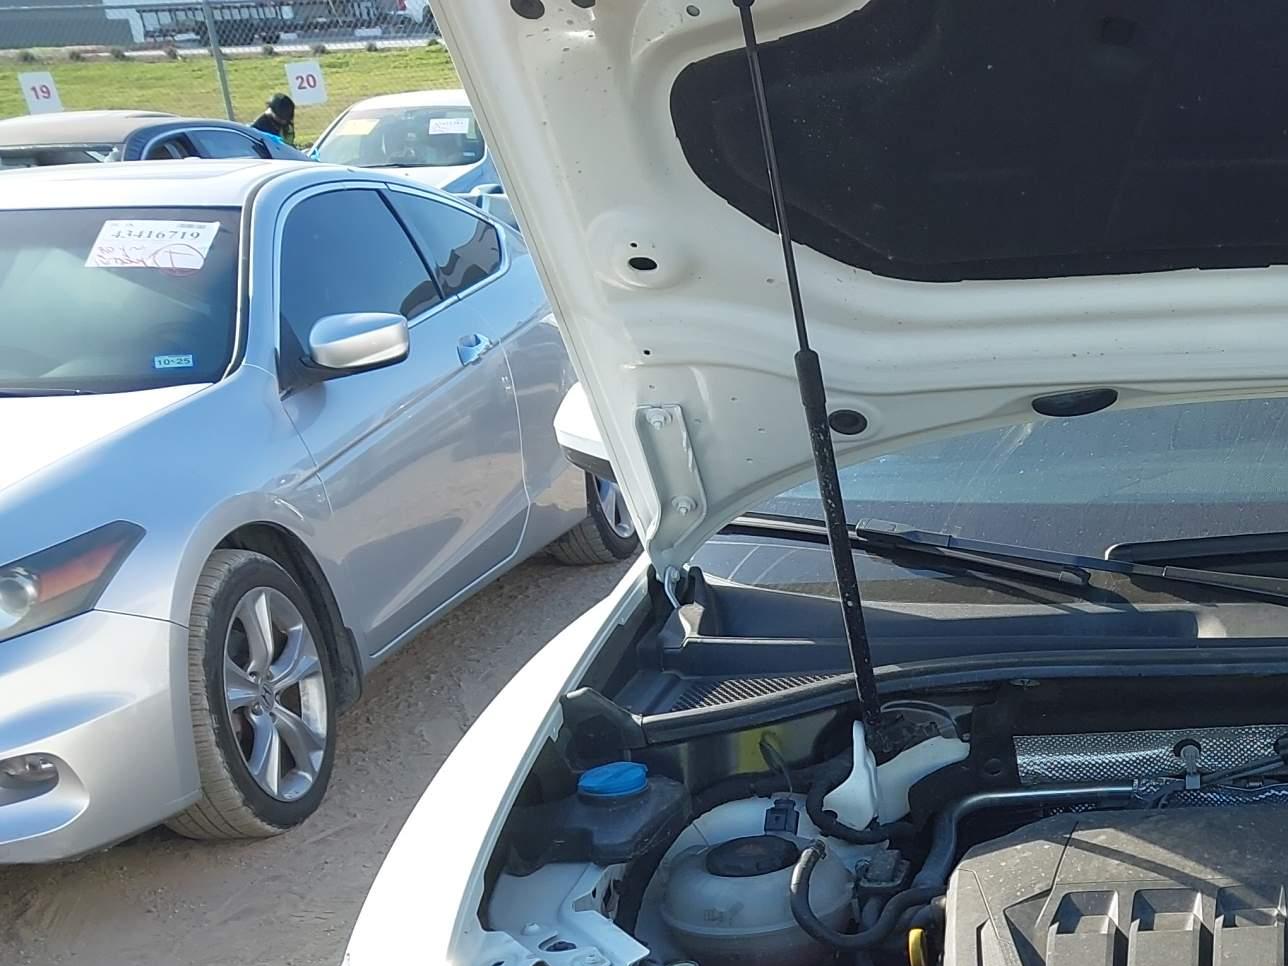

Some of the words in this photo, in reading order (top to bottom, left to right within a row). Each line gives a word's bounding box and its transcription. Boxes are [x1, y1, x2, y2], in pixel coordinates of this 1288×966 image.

[295, 73, 317, 91] 20
[31, 84, 51, 100] 19
[111, 230, 201, 240] 43416719
